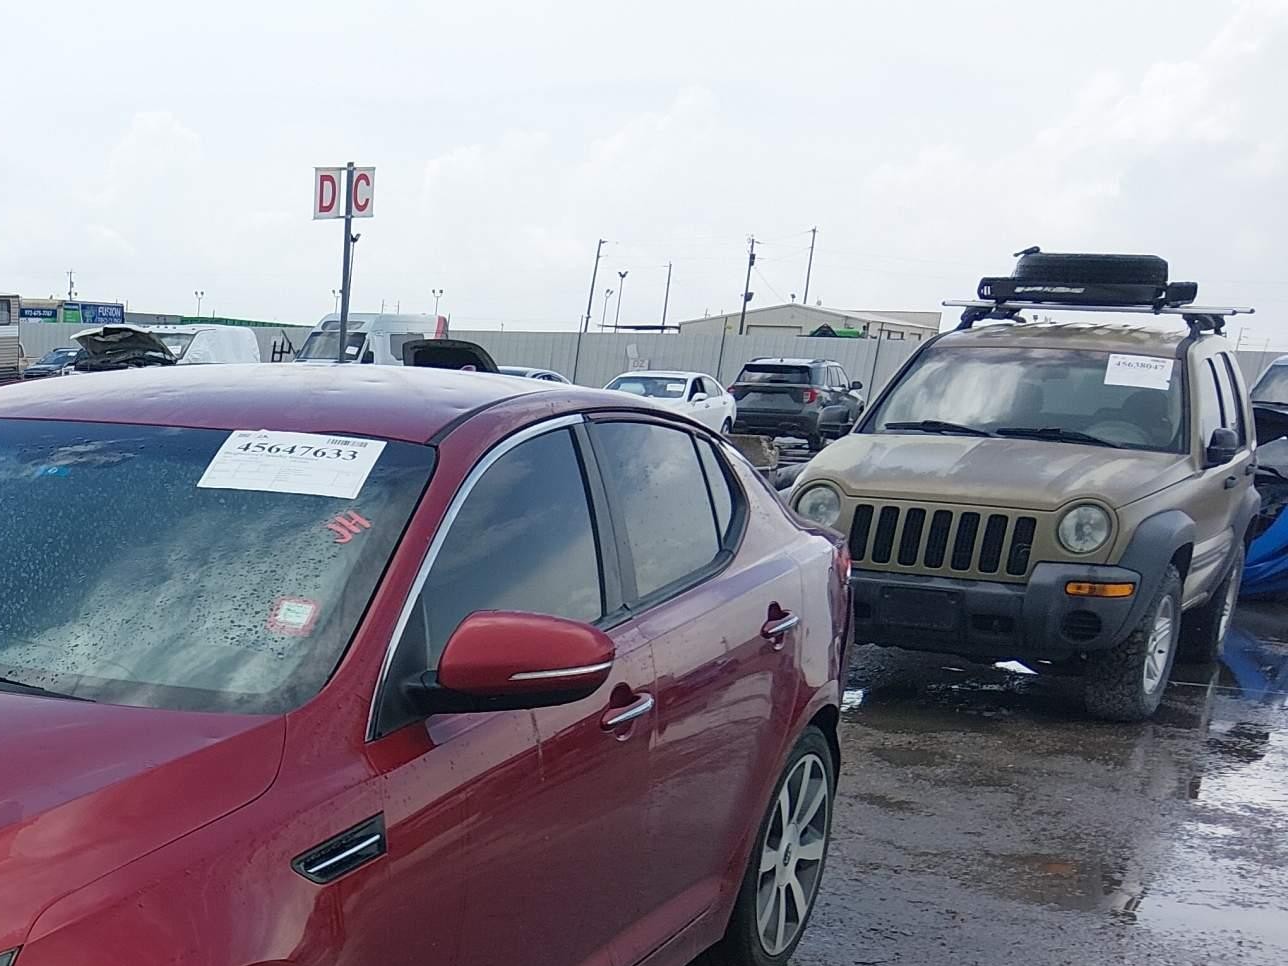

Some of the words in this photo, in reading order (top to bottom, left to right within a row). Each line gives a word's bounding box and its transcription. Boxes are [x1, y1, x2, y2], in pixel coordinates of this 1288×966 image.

[319, 174, 337, 213] D
[353, 173, 371, 212] C
[98, 306, 121, 317] FUSION
[237, 442, 359, 461] 45647633
